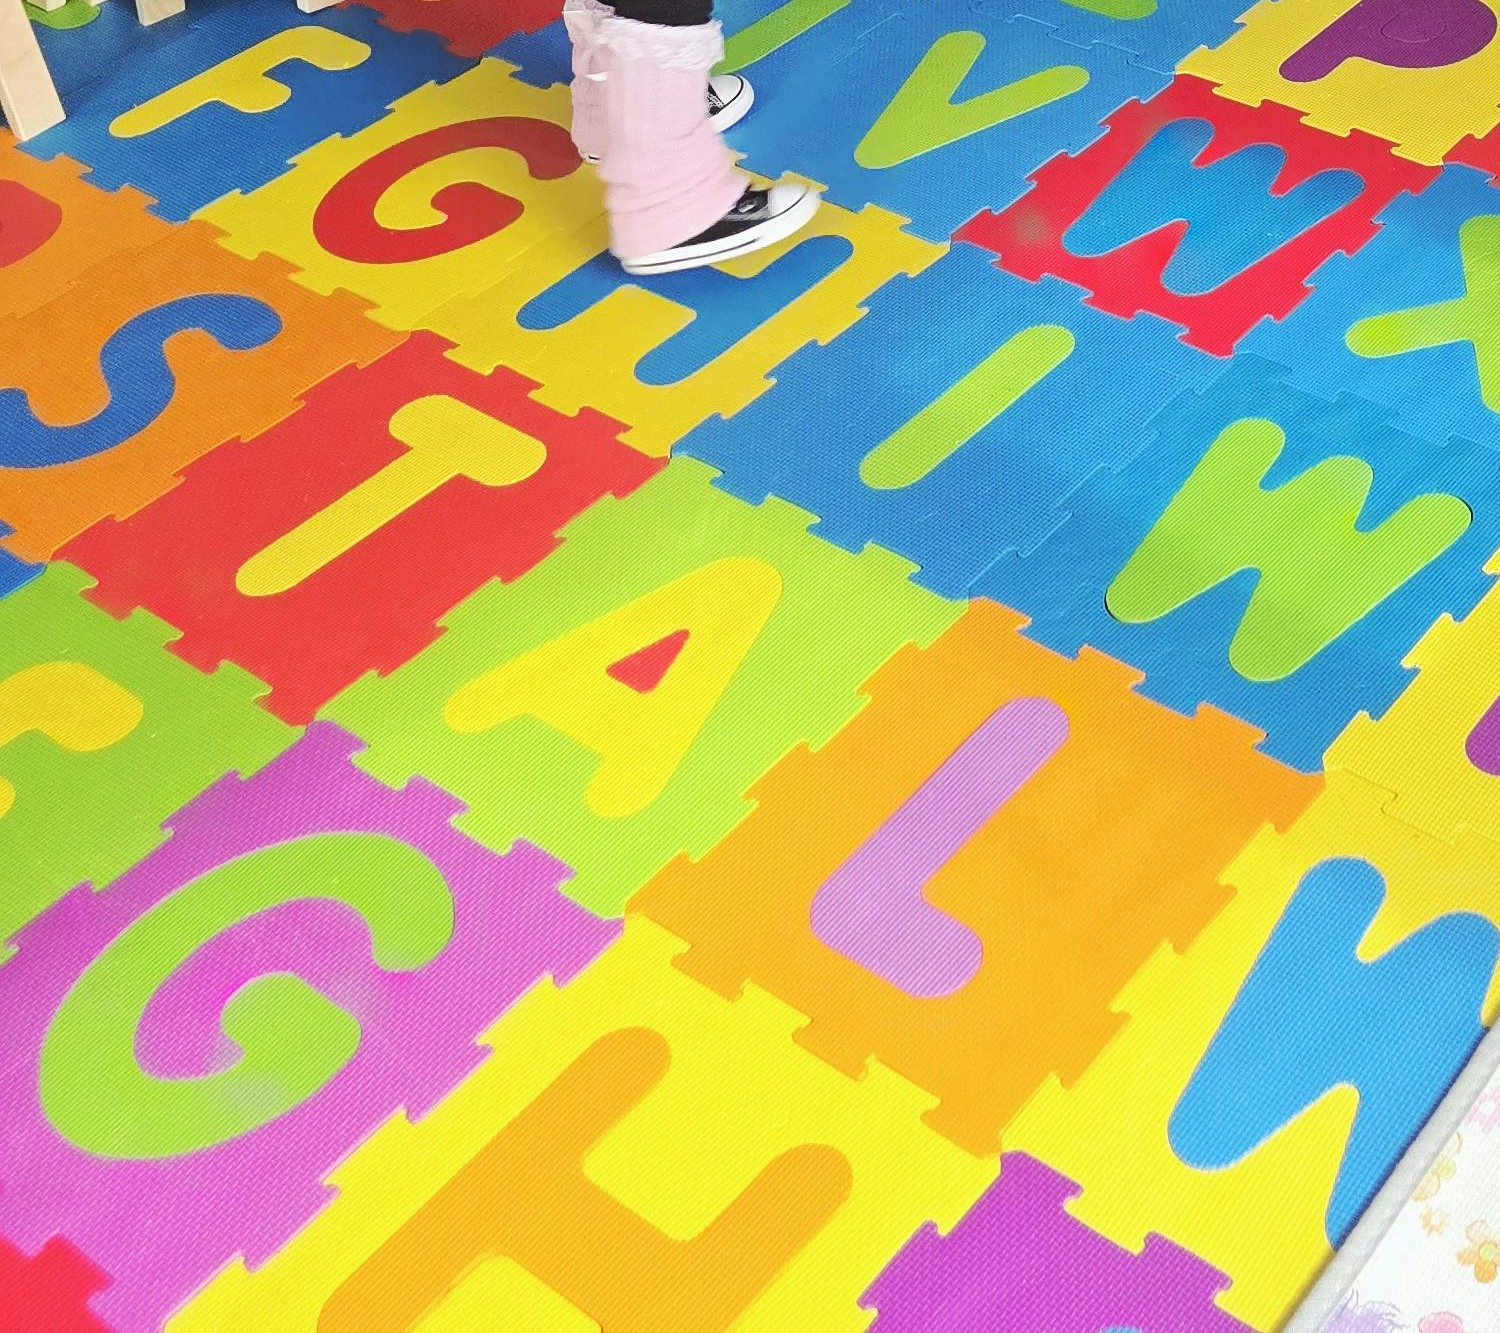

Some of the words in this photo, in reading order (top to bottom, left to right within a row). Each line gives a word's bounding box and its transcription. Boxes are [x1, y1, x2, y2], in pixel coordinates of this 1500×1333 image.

[108, 25, 372, 139] F
[854, 29, 1091, 169] V
[312, 116, 581, 265] G
[1061, 117, 1366, 297] W
[0, 293, 283, 469] S
[859, 323, 1076, 490] I
[234, 394, 548, 597] T
[1104, 417, 1473, 682] W
[443, 557, 784, 818] A
[810, 695, 1071, 997] L
[38, 829, 455, 1160] G
